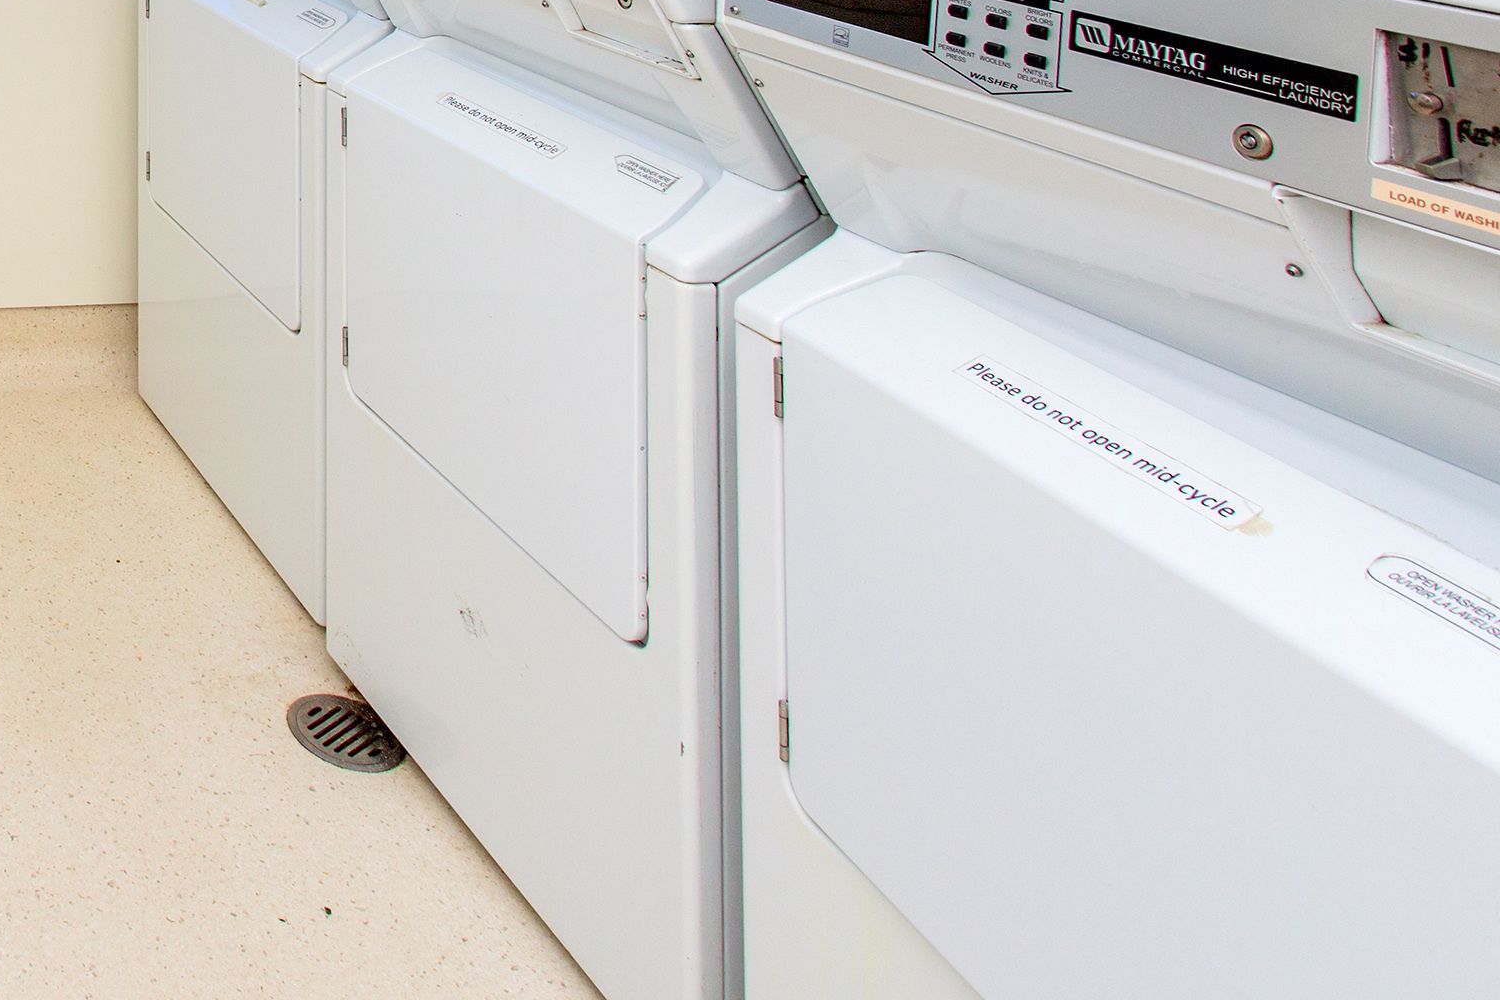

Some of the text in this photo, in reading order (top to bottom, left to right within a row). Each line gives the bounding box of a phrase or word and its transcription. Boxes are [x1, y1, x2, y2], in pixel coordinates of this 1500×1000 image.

[985, 4, 1012, 17] COLORS
[1025, 14, 1053, 27] COLORS
[1027, 7, 1053, 18] BRIGHT
[938, 43, 975, 58] PERMANENT
[946, 53, 967, 63] PRESS
[1113, 34, 1207, 71] MAYTAG
[980, 55, 1012, 69] WOOLENS
[1022, 66, 1043, 78] KNITS
[1112, 50, 1205, 78] COMMERCIAL
[970, 71, 1019, 91] WASHER
[1017, 73, 1054, 88] DELICATES
[1222, 64, 1354, 104] HIGH EFFICIENCY
[1278, 88, 1353, 115] LAUNDRY
[446, 96, 559, 155] Please do not open mid-cycle
[1389, 190, 1427, 209] LOAD
[1431, 202, 1450, 215] OF
[966, 362, 1237, 519] Please do not open mid-cycle
[1388, 572, 1436, 600] OUVRIR
[1432, 598, 1451, 609] LA
[1407, 570, 1497, 621] OPEN WASHER
